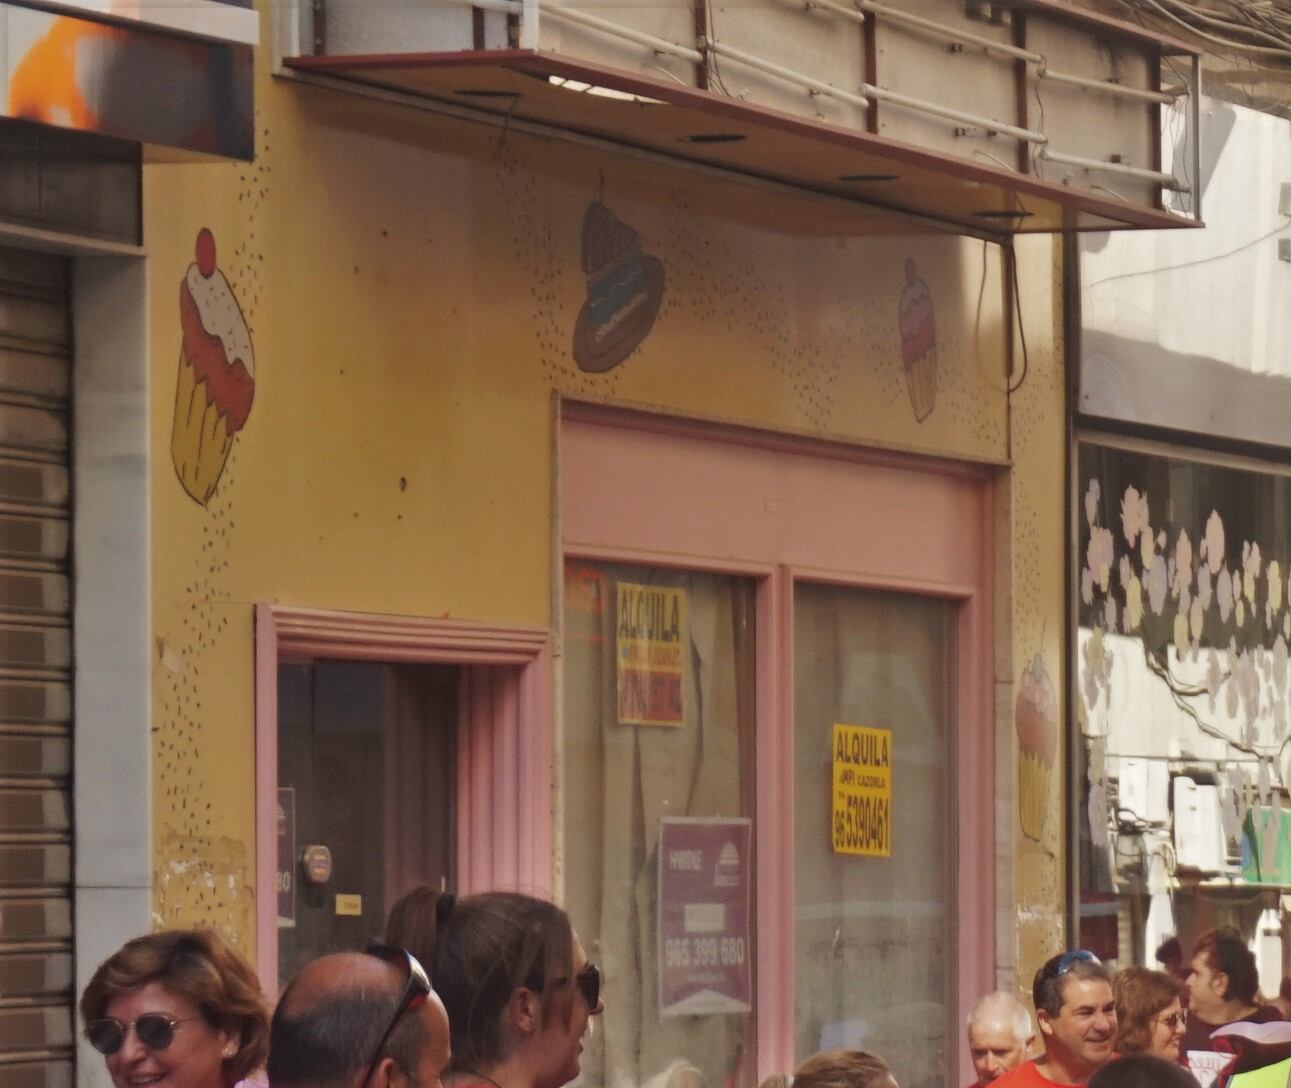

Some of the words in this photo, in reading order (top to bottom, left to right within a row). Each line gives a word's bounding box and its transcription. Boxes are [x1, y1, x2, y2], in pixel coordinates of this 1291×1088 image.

[619, 589, 680, 642] ALQUILA
[836, 730, 889, 768] ALQUILA
[846, 795, 889, 851] 5390461
[665, 937, 690, 967] 965
[693, 937, 718, 966] 399
[720, 936, 745, 965] 680
